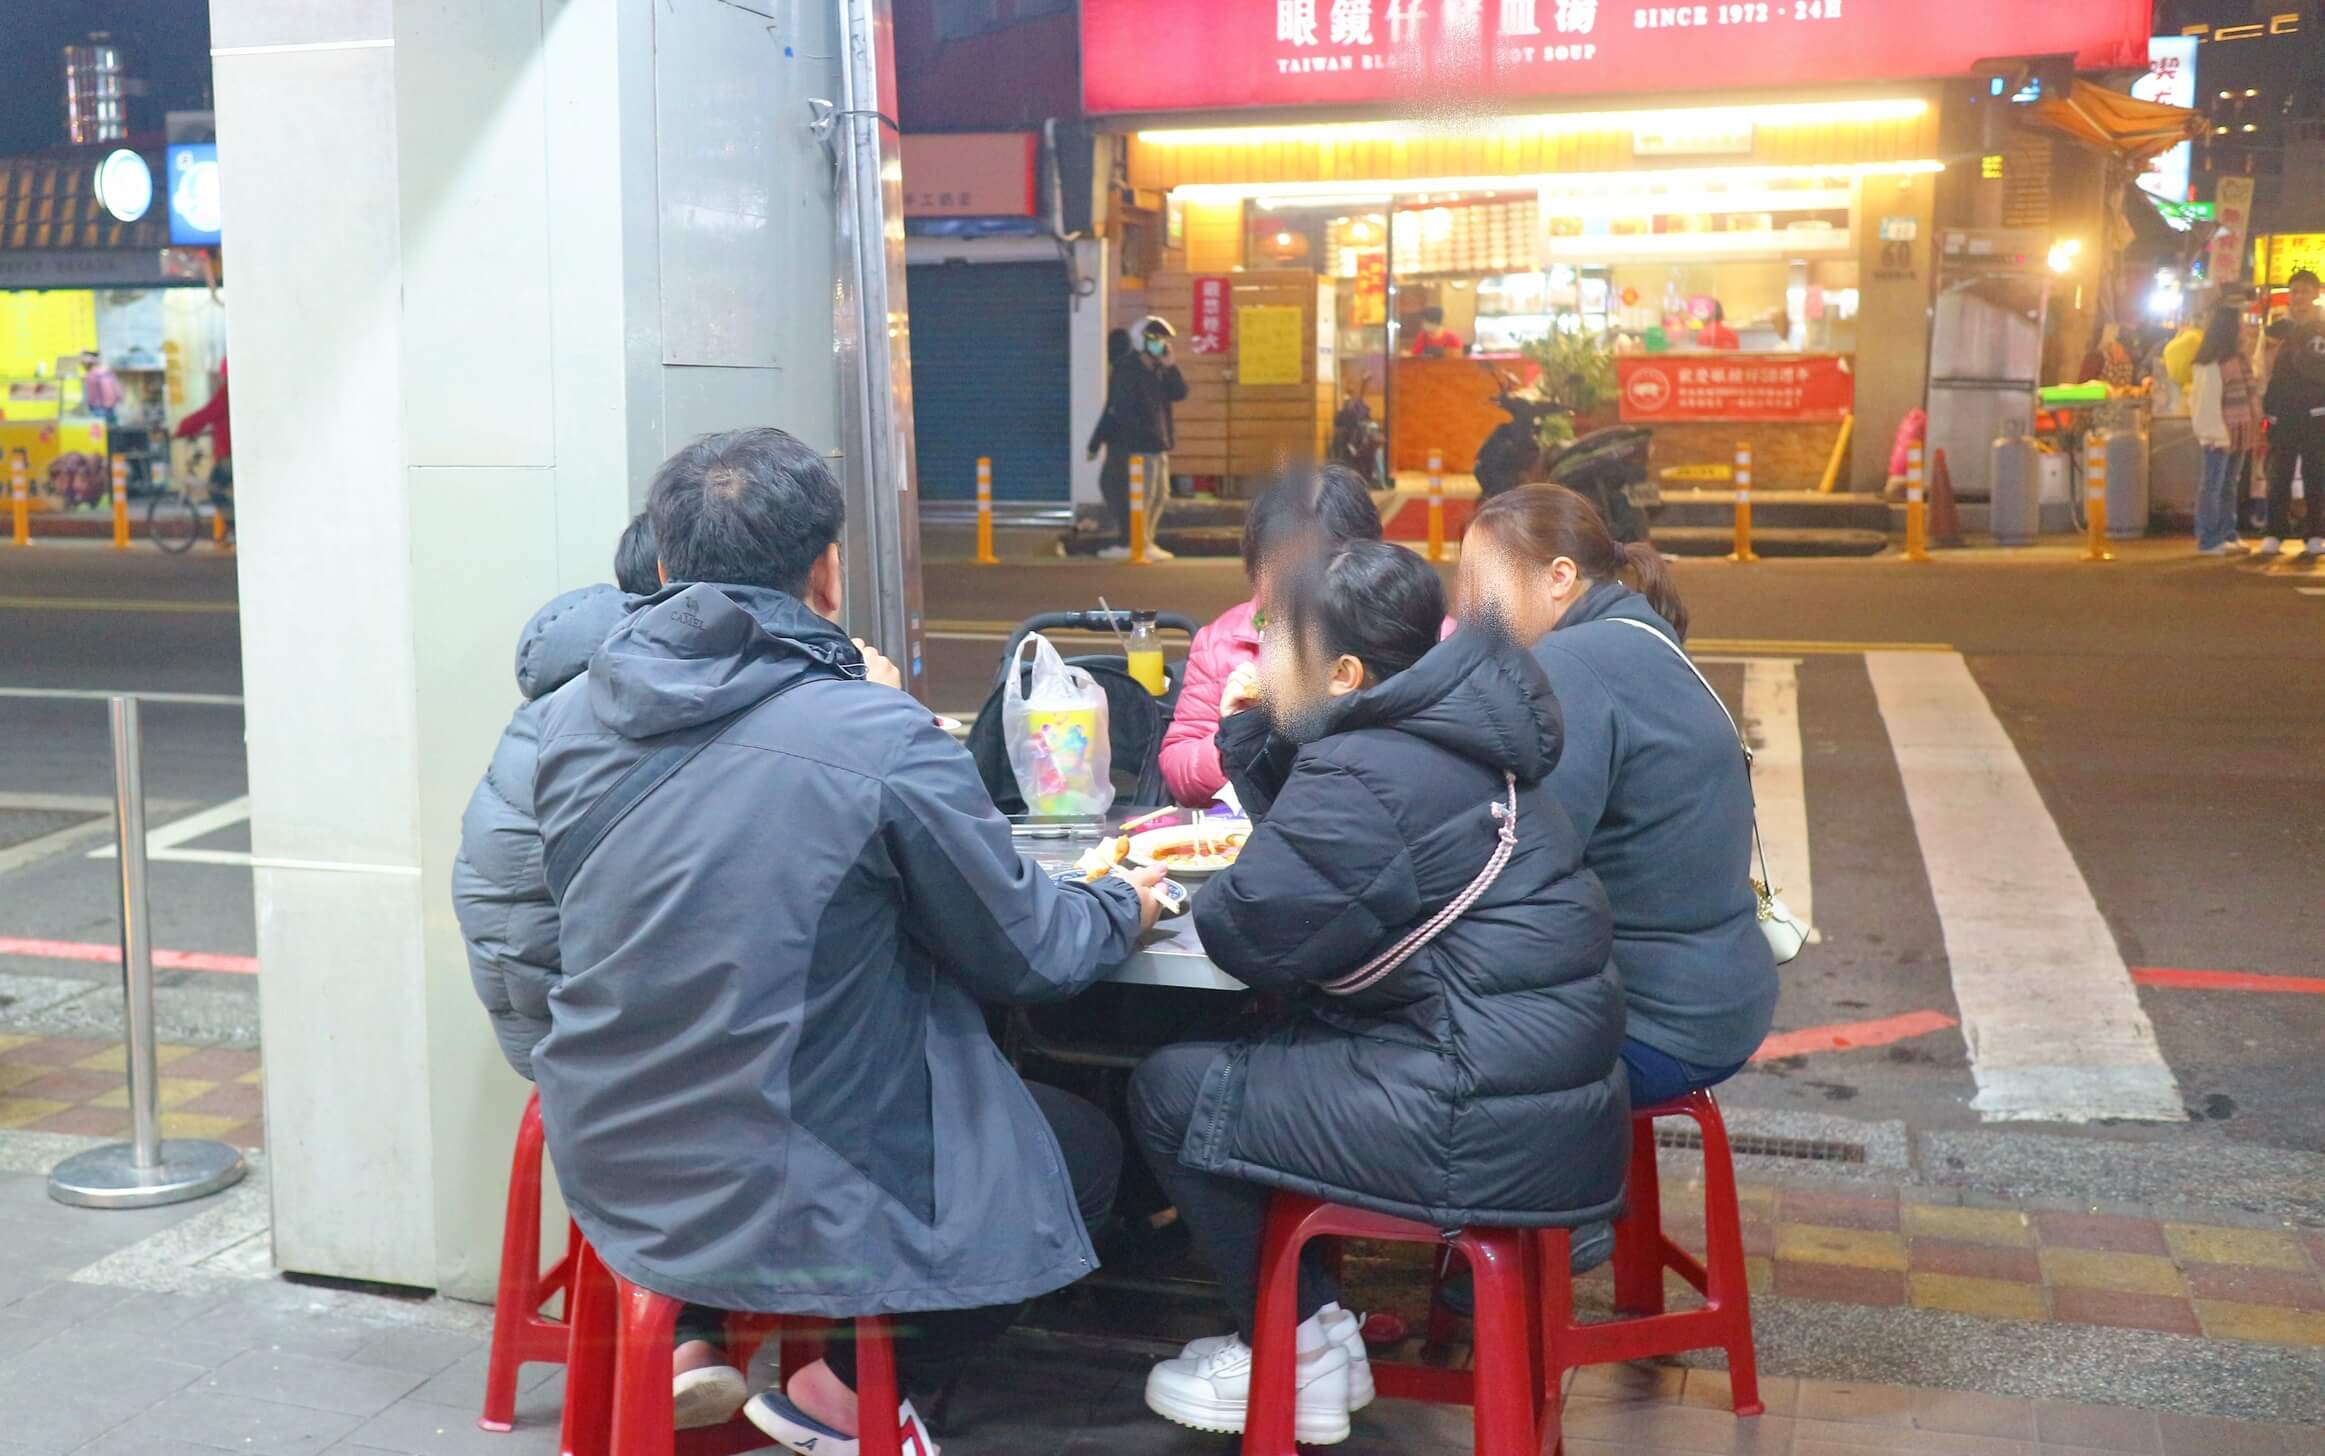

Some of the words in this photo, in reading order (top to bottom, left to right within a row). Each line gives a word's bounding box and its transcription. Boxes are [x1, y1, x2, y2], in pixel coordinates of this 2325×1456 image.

[1633, 6, 1709, 29] SINCE
[1717, 3, 1769, 25] 1972
[1793, 0, 1842, 20] 24H
[1276, 56, 1353, 74] TAIWAN
[1543, 43, 1597, 62] SOUP
